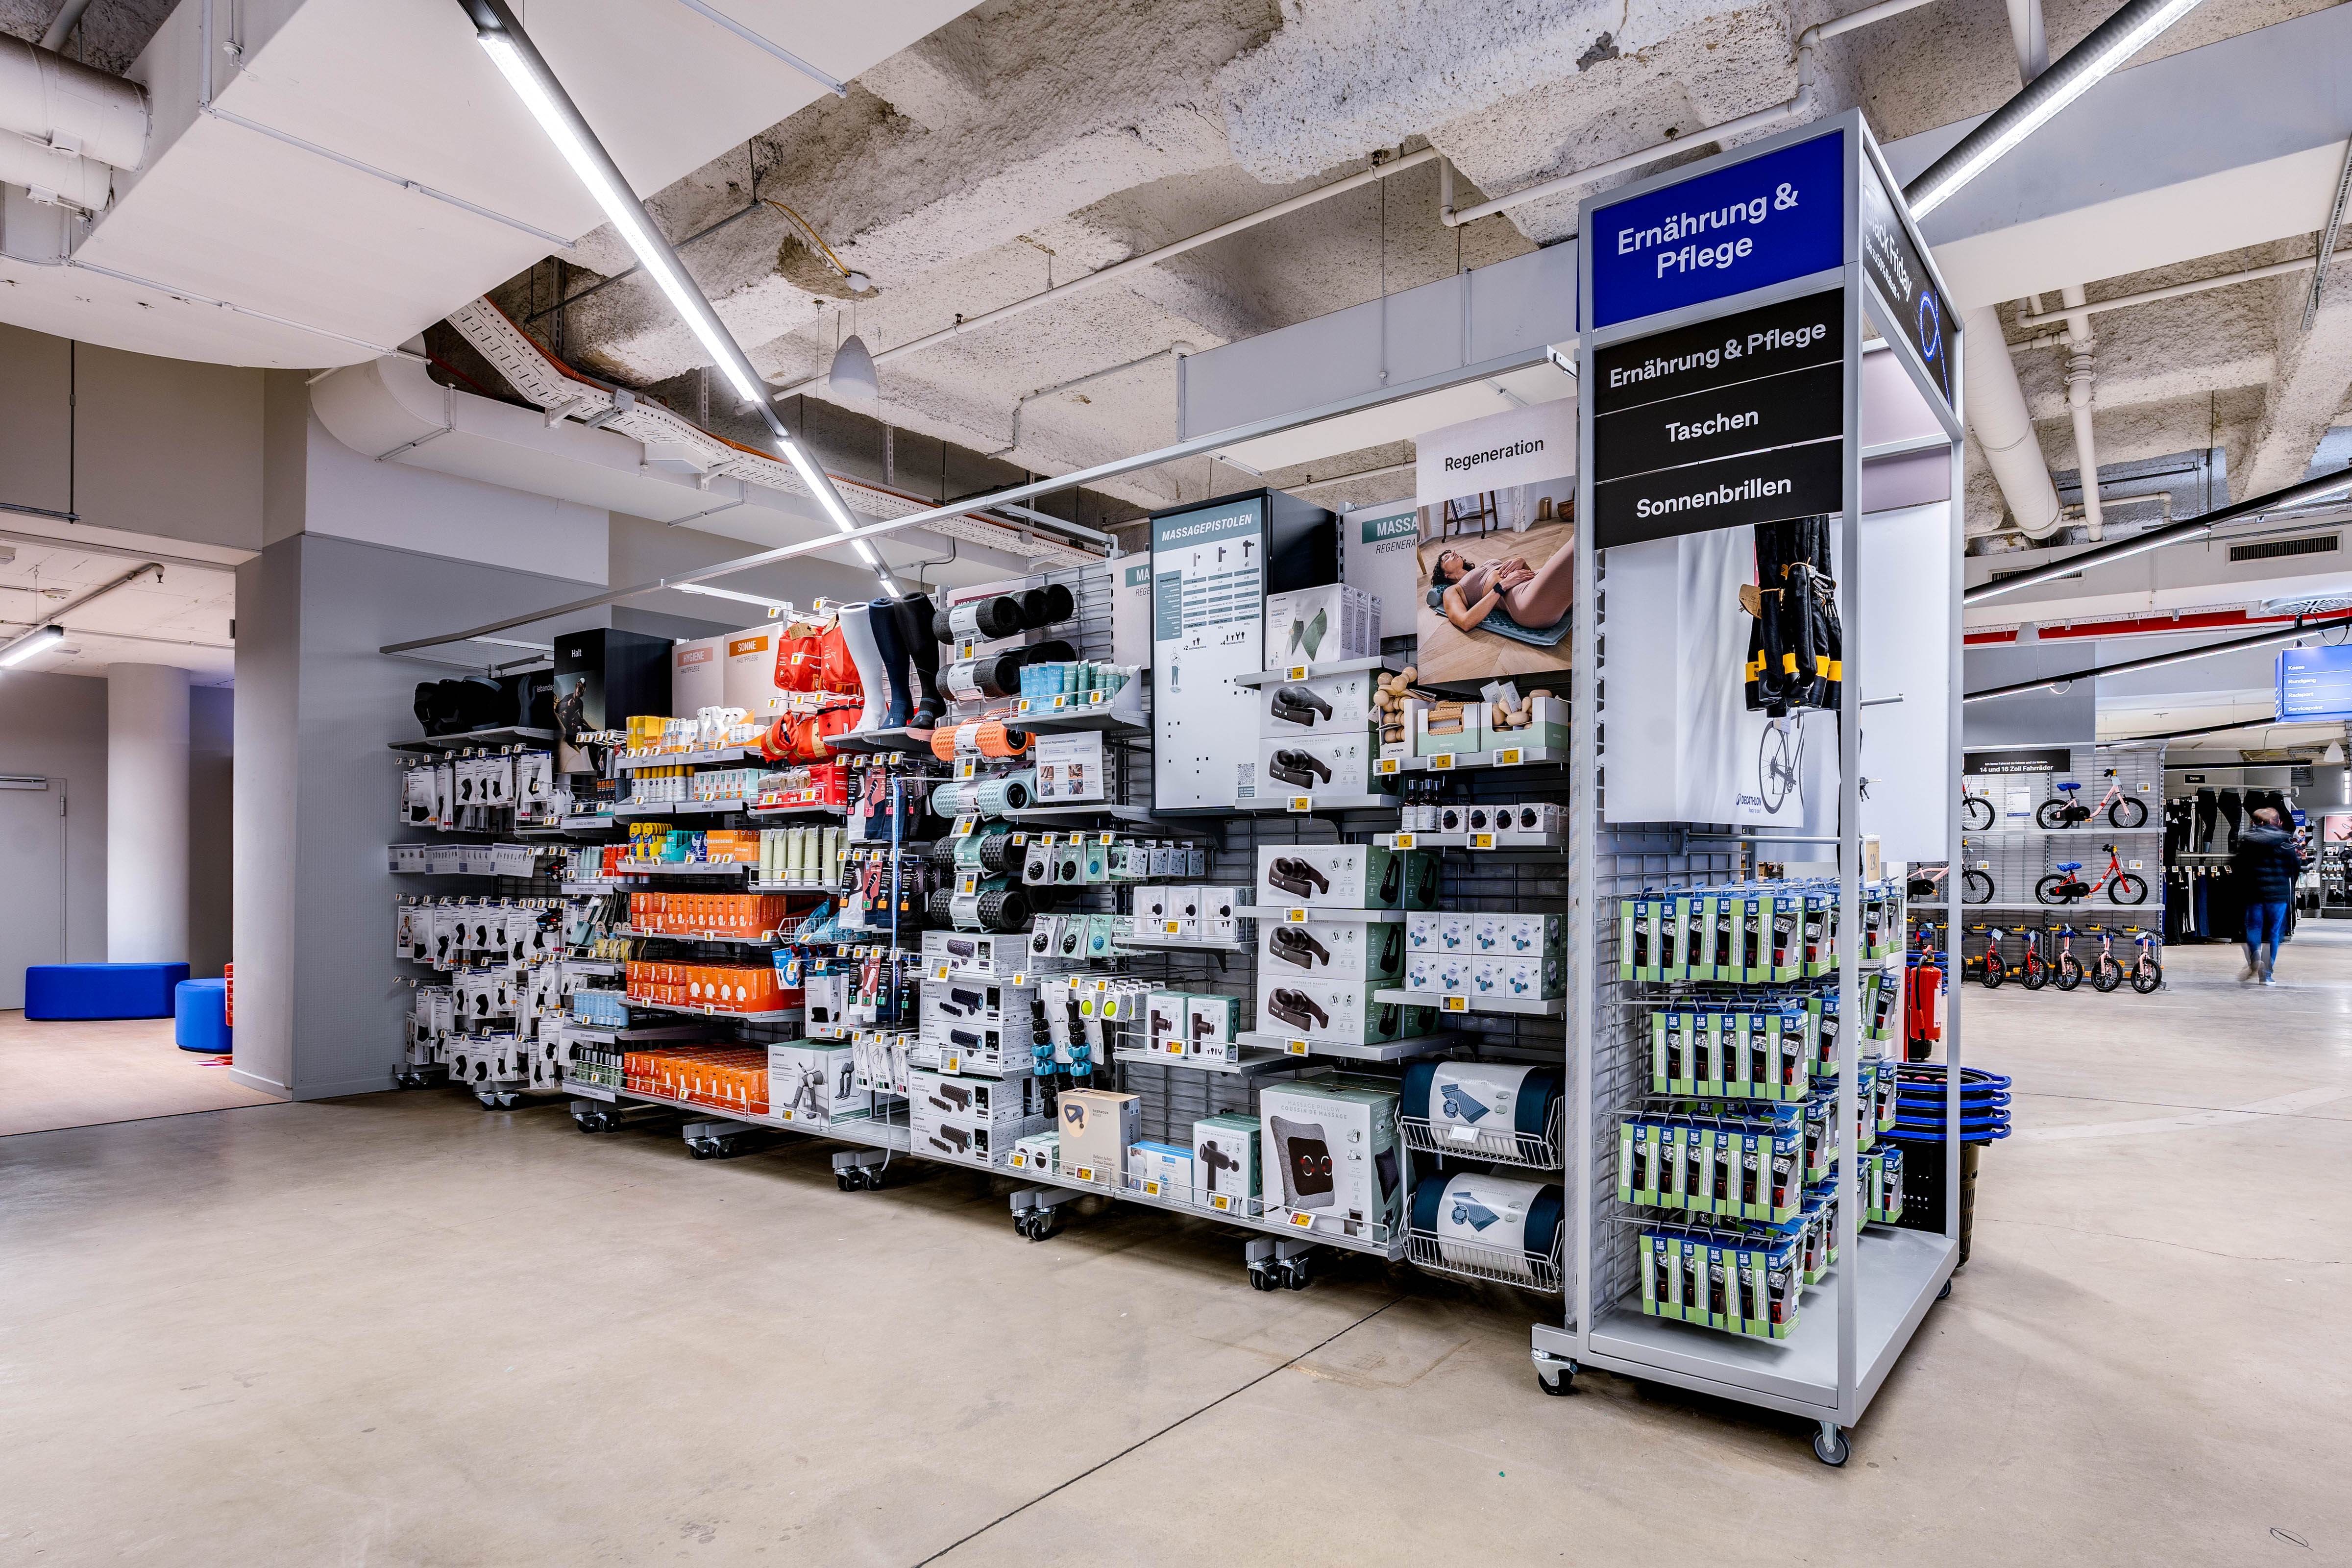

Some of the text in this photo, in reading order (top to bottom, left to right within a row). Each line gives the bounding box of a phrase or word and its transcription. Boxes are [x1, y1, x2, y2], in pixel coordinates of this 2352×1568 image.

[1618, 183, 1799, 255] Ernährung &
[1657, 237, 1753, 278] Pflege
[1865, 190, 1912, 302] Black Friday
[1877, 253, 1886, 278] 50%
[1610, 323, 1826, 388] Ernährung & Pflege
[1666, 409, 1759, 442] Taschen
[1445, 437, 1544, 473] Regeneration
[1636, 478, 1791, 519] Sonnenbrillen
[1162, 514, 1252, 541] MASSAGEPISTOLEN
[1377, 515, 1417, 537] MASSA
[1376, 538, 1416, 554] REGENERA
[571, 649, 582, 658] Halt
[683, 651, 705, 663] HYGIENE
[737, 640, 757, 653] SONNE
[736, 654, 759, 663] HAUTPFLEGE
[1741, 795, 1762, 806] DECATHLON
[1281, 1105, 1307, 1114] COUSSIN
[1319, 1111, 1347, 1120] MASSAGE
[1287, 1101, 1315, 1109] MASSAGE
